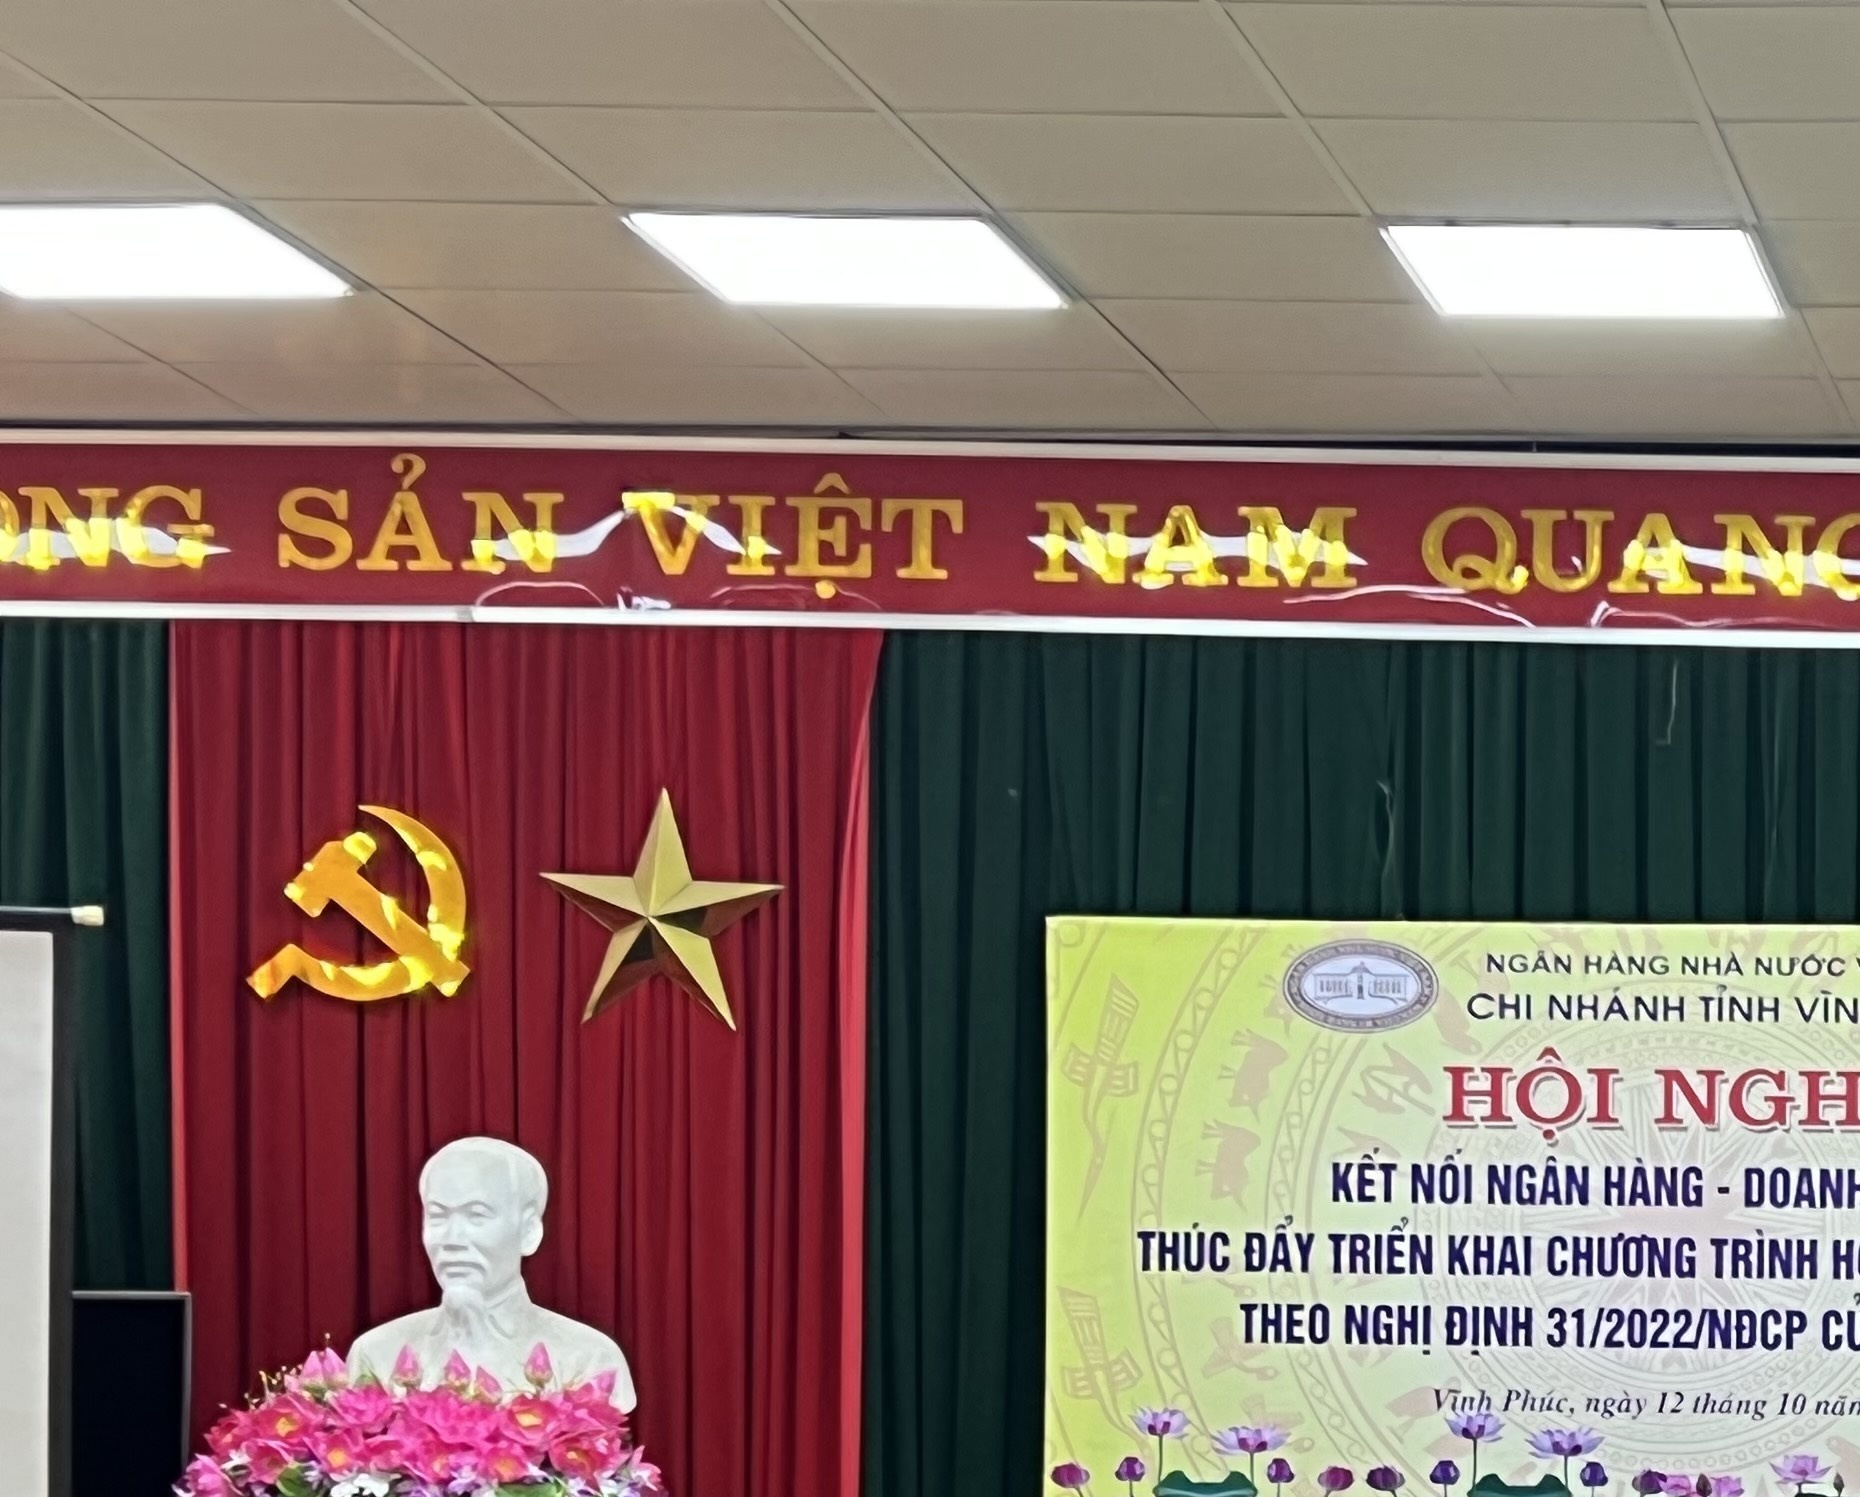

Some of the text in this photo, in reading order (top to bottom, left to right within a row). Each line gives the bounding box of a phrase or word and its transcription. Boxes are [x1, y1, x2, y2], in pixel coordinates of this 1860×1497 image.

[0, 485, 215, 571] NG
[278, 453, 565, 573] SẢN
[623, 473, 963, 599] VIỆT
[1034, 502, 1359, 588] NAM
[1486, 950, 1572, 975] NGÂN
[1584, 950, 1670, 976] HÀNG
[1681, 950, 1744, 977] NHÀ
[1466, 992, 1532, 1020] CHI
[1547, 986, 1685, 1022] NHÁNH
[1698, 984, 1780, 1023] TỈNH
[1443, 1047, 1620, 1146] HỘI
[1332, 1147, 1397, 1204] KẾT
[1410, 1148, 1473, 1205] NỐI
[1486, 1156, 1590, 1207] NGÂN
[1604, 1157, 1704, 1208] HÀNG
[1717, 1186, 1730, 1195] -
[1137, 1222, 1230, 1272] THÚC
[1244, 1216, 1315, 1273] ĐẨY
[1328, 1216, 1434, 1275] TRIỂN
[1447, 1234, 1532, 1277] KHAI
[1545, 1233, 1696, 1279] CHƯƠNG
[1710, 1229, 1818, 1280] TRÌNH
[1240, 1303, 1330, 1344] THEO
[1343, 1304, 1432, 1355] NGHỊ
[1445, 1305, 1534, 1355] ĐỊNH
[1545, 1306, 1808, 1351] 31/2022/NĐCP
[1432, 1388, 1492, 1413] Vĩnh
[1502, 1388, 1576, 1417] Phúc,
[1585, 1391, 1648, 1419] ngày
[1656, 1391, 1685, 1413] 12
[1692, 1390, 1768, 1420] tháng
[1777, 1392, 1807, 1415] 10
